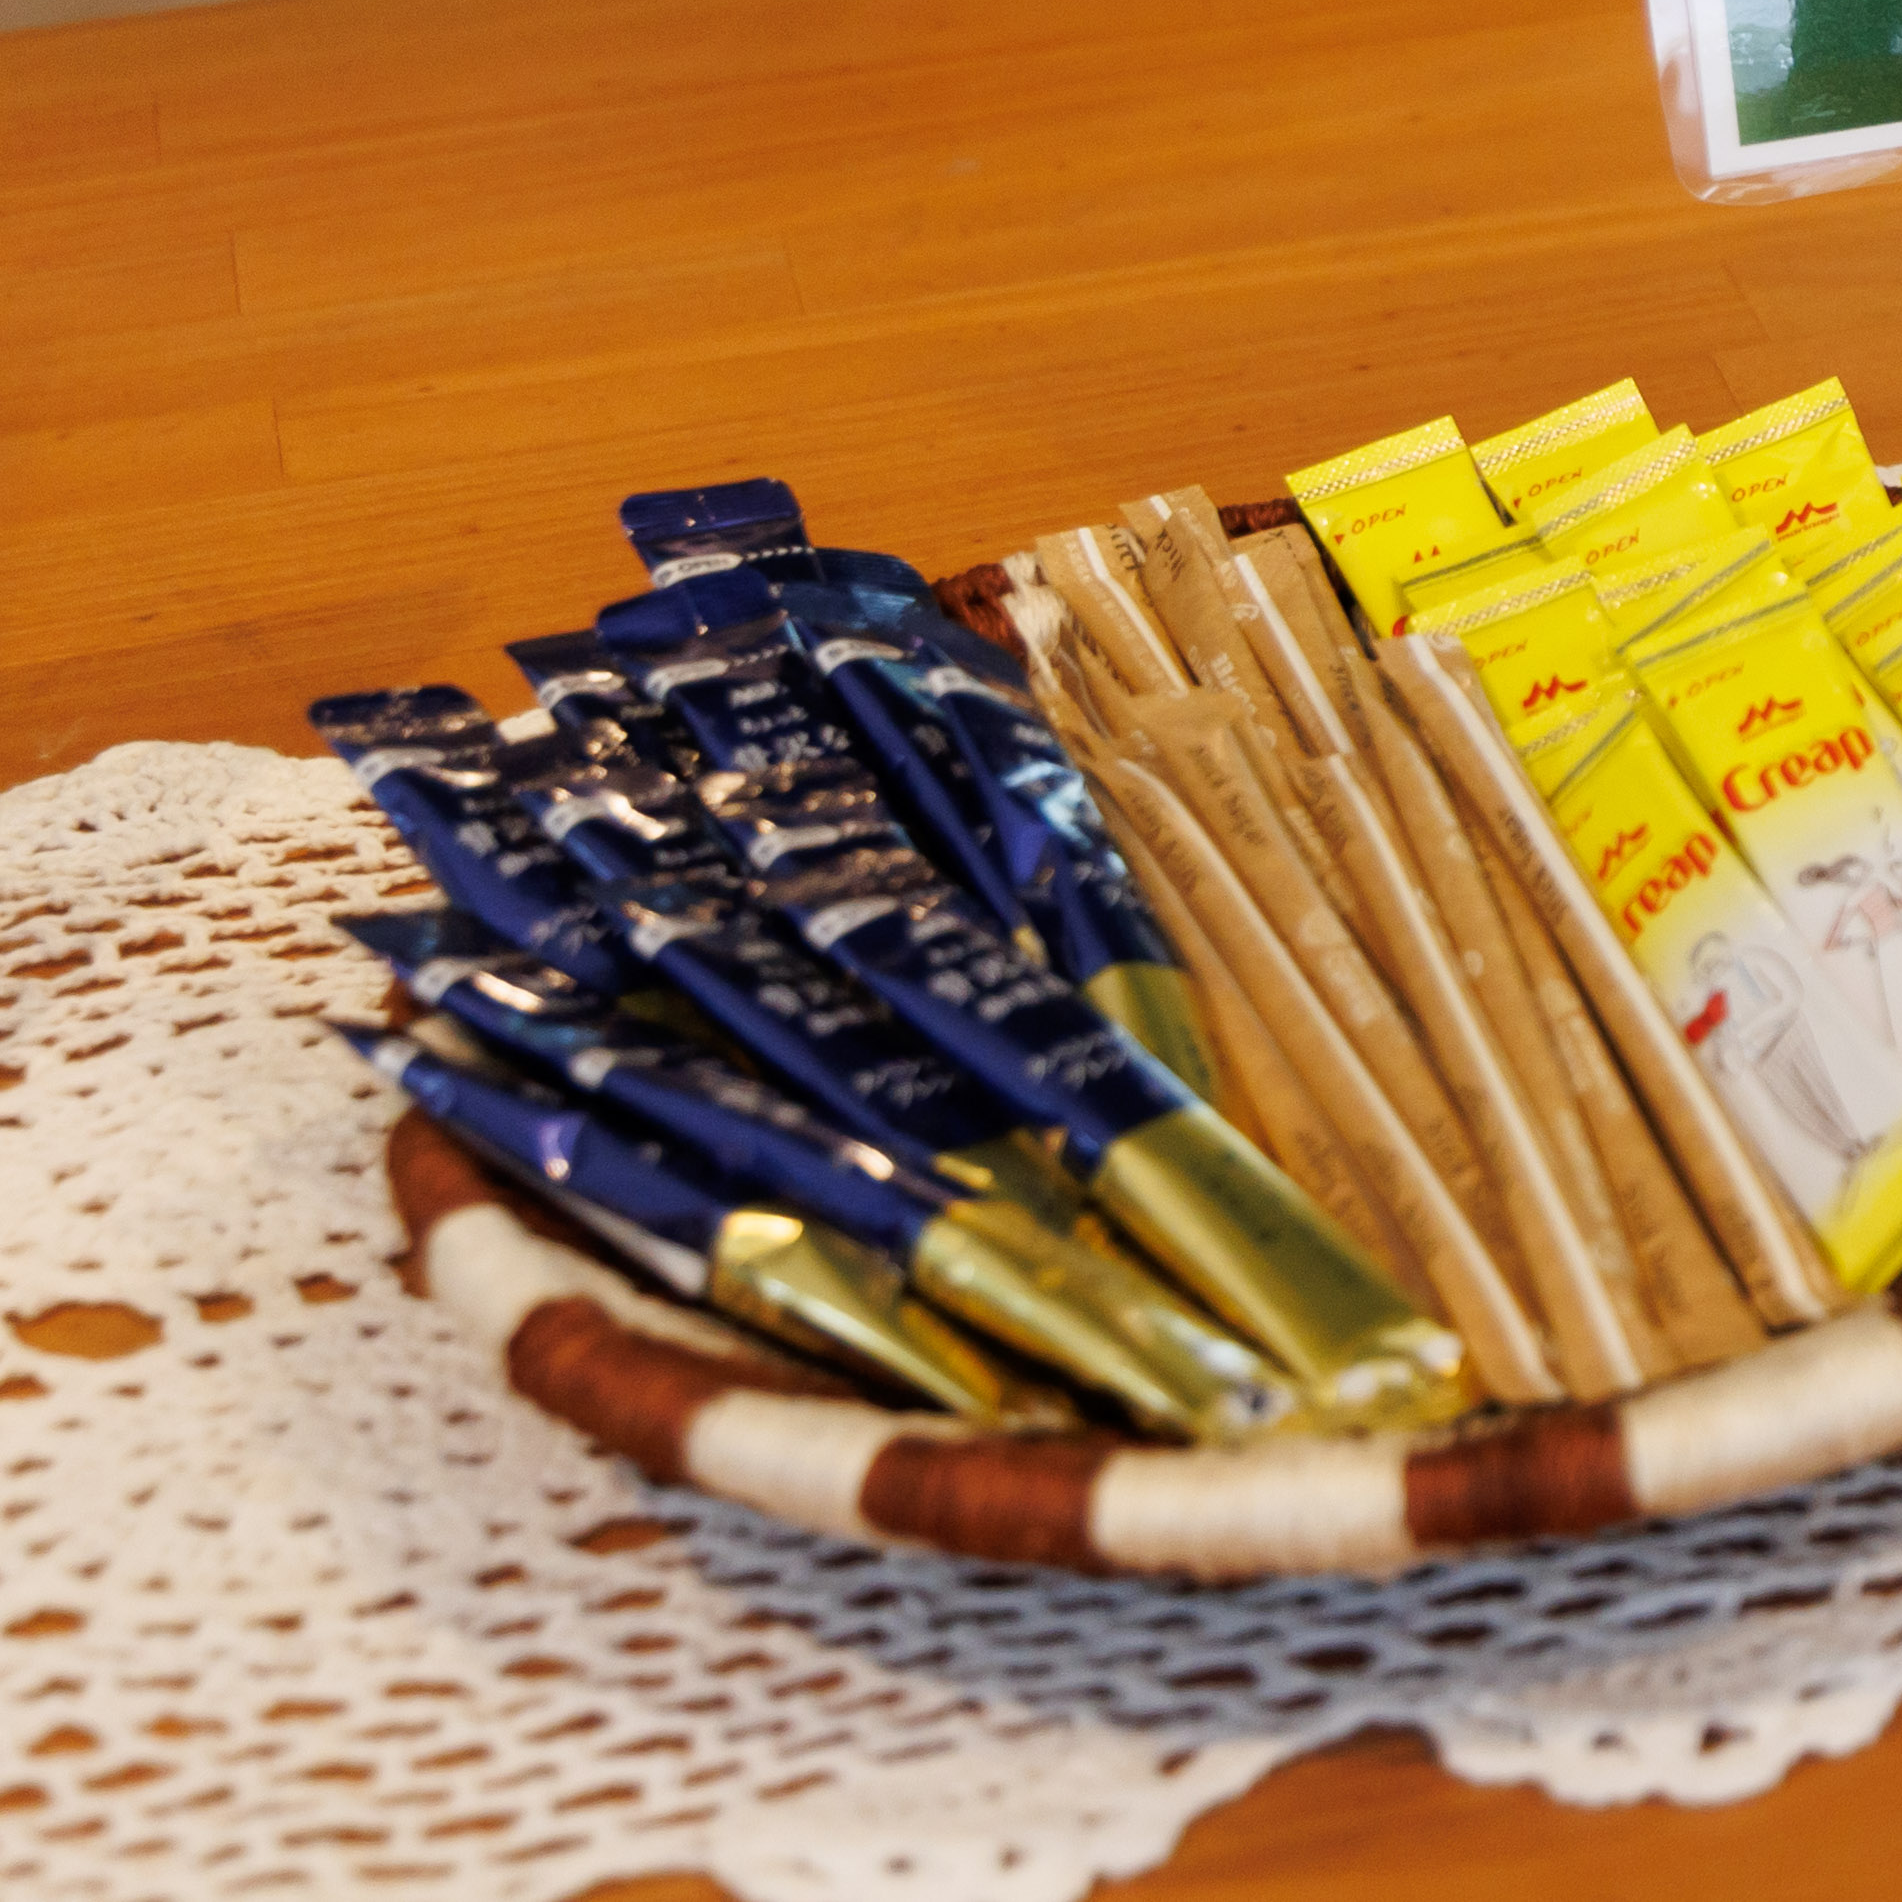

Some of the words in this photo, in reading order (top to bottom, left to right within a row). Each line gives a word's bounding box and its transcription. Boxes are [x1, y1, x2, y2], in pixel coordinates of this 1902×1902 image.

[1527, 466, 1585, 498] OPEN
[1730, 472, 1790, 503] OPEN
[1350, 503, 1408, 536] OPEN
[1585, 527, 1641, 565] OPEN
[1720, 725, 1875, 813] Creap
[1617, 830, 1721, 938] reap
